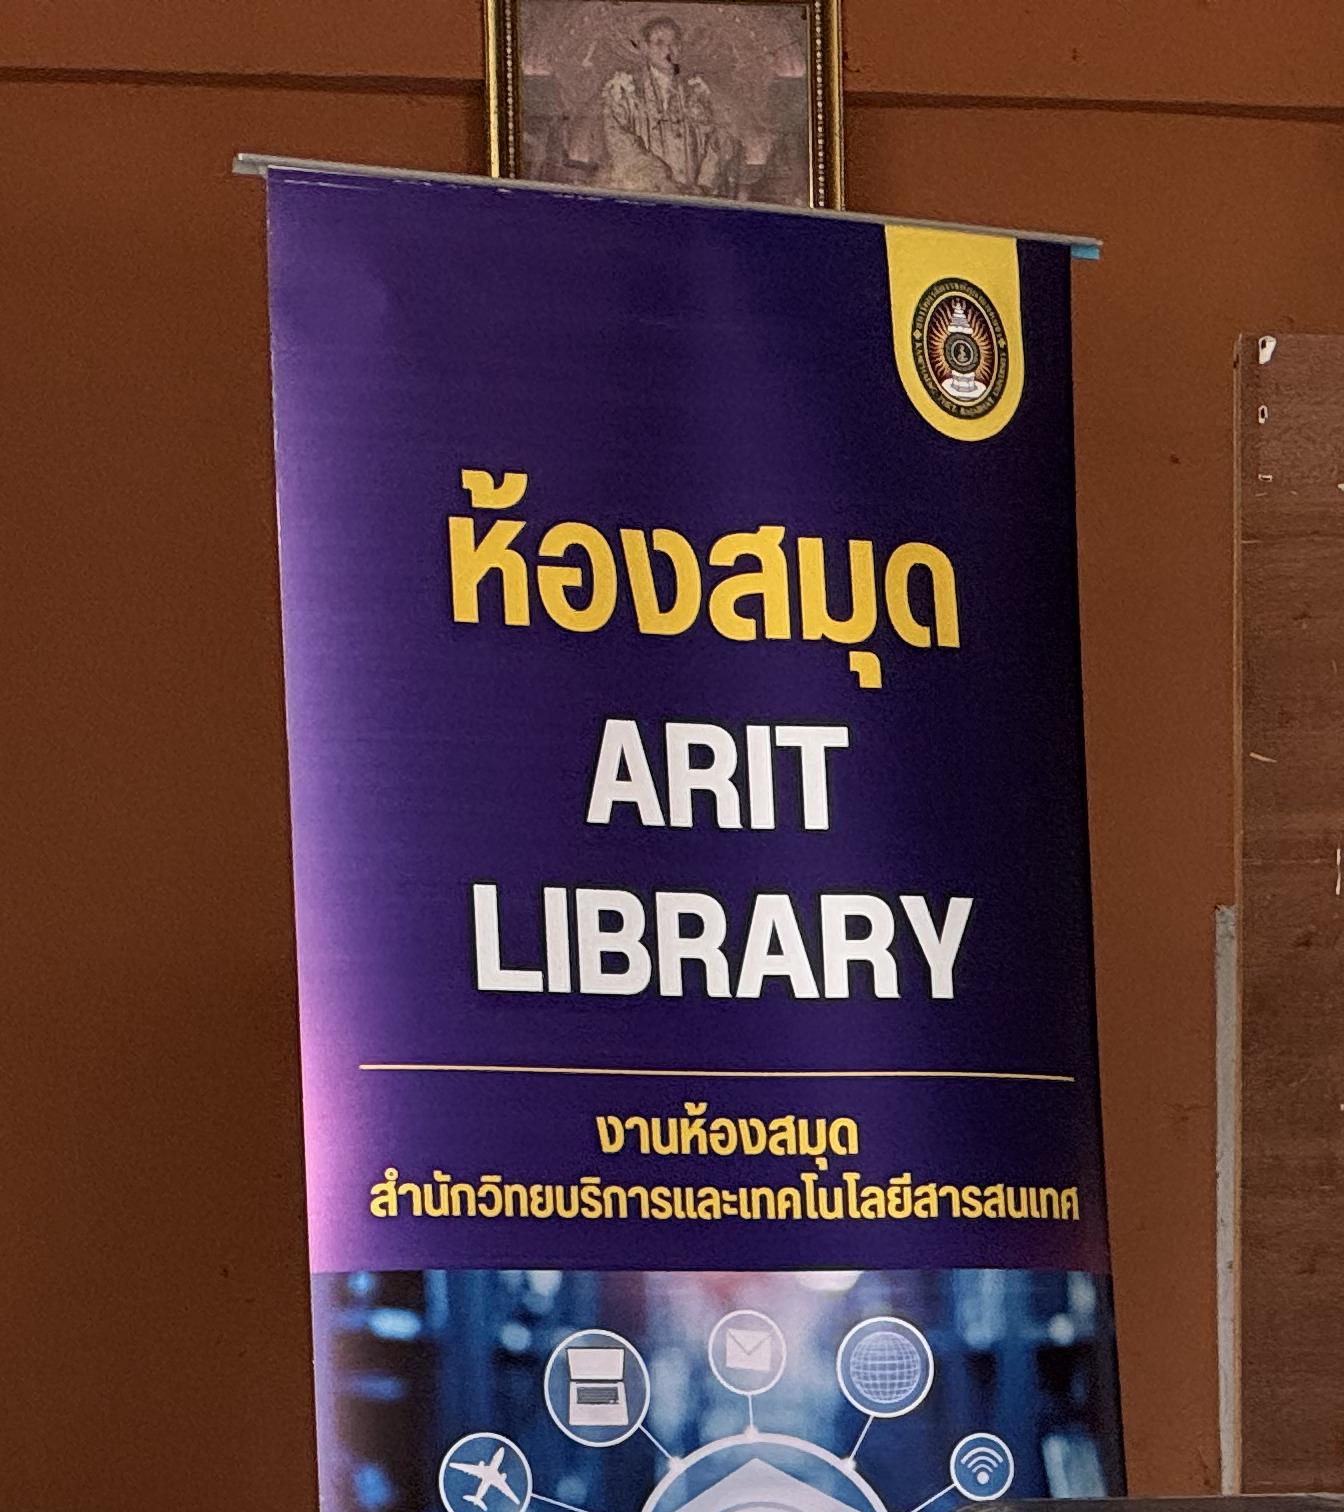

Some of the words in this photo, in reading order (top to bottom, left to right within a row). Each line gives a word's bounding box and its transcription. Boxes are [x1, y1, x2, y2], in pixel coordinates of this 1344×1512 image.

[448, 469, 962, 689] ห้องสมุด
[586, 719, 850, 831] ARIT
[472, 883, 974, 1001] LIBRARY
[597, 1102, 859, 1171] งานห้องสมุด
[369, 1167, 1081, 1222] สำนักวิทยบริการและเทคโนโลยีสารสนเทศ
